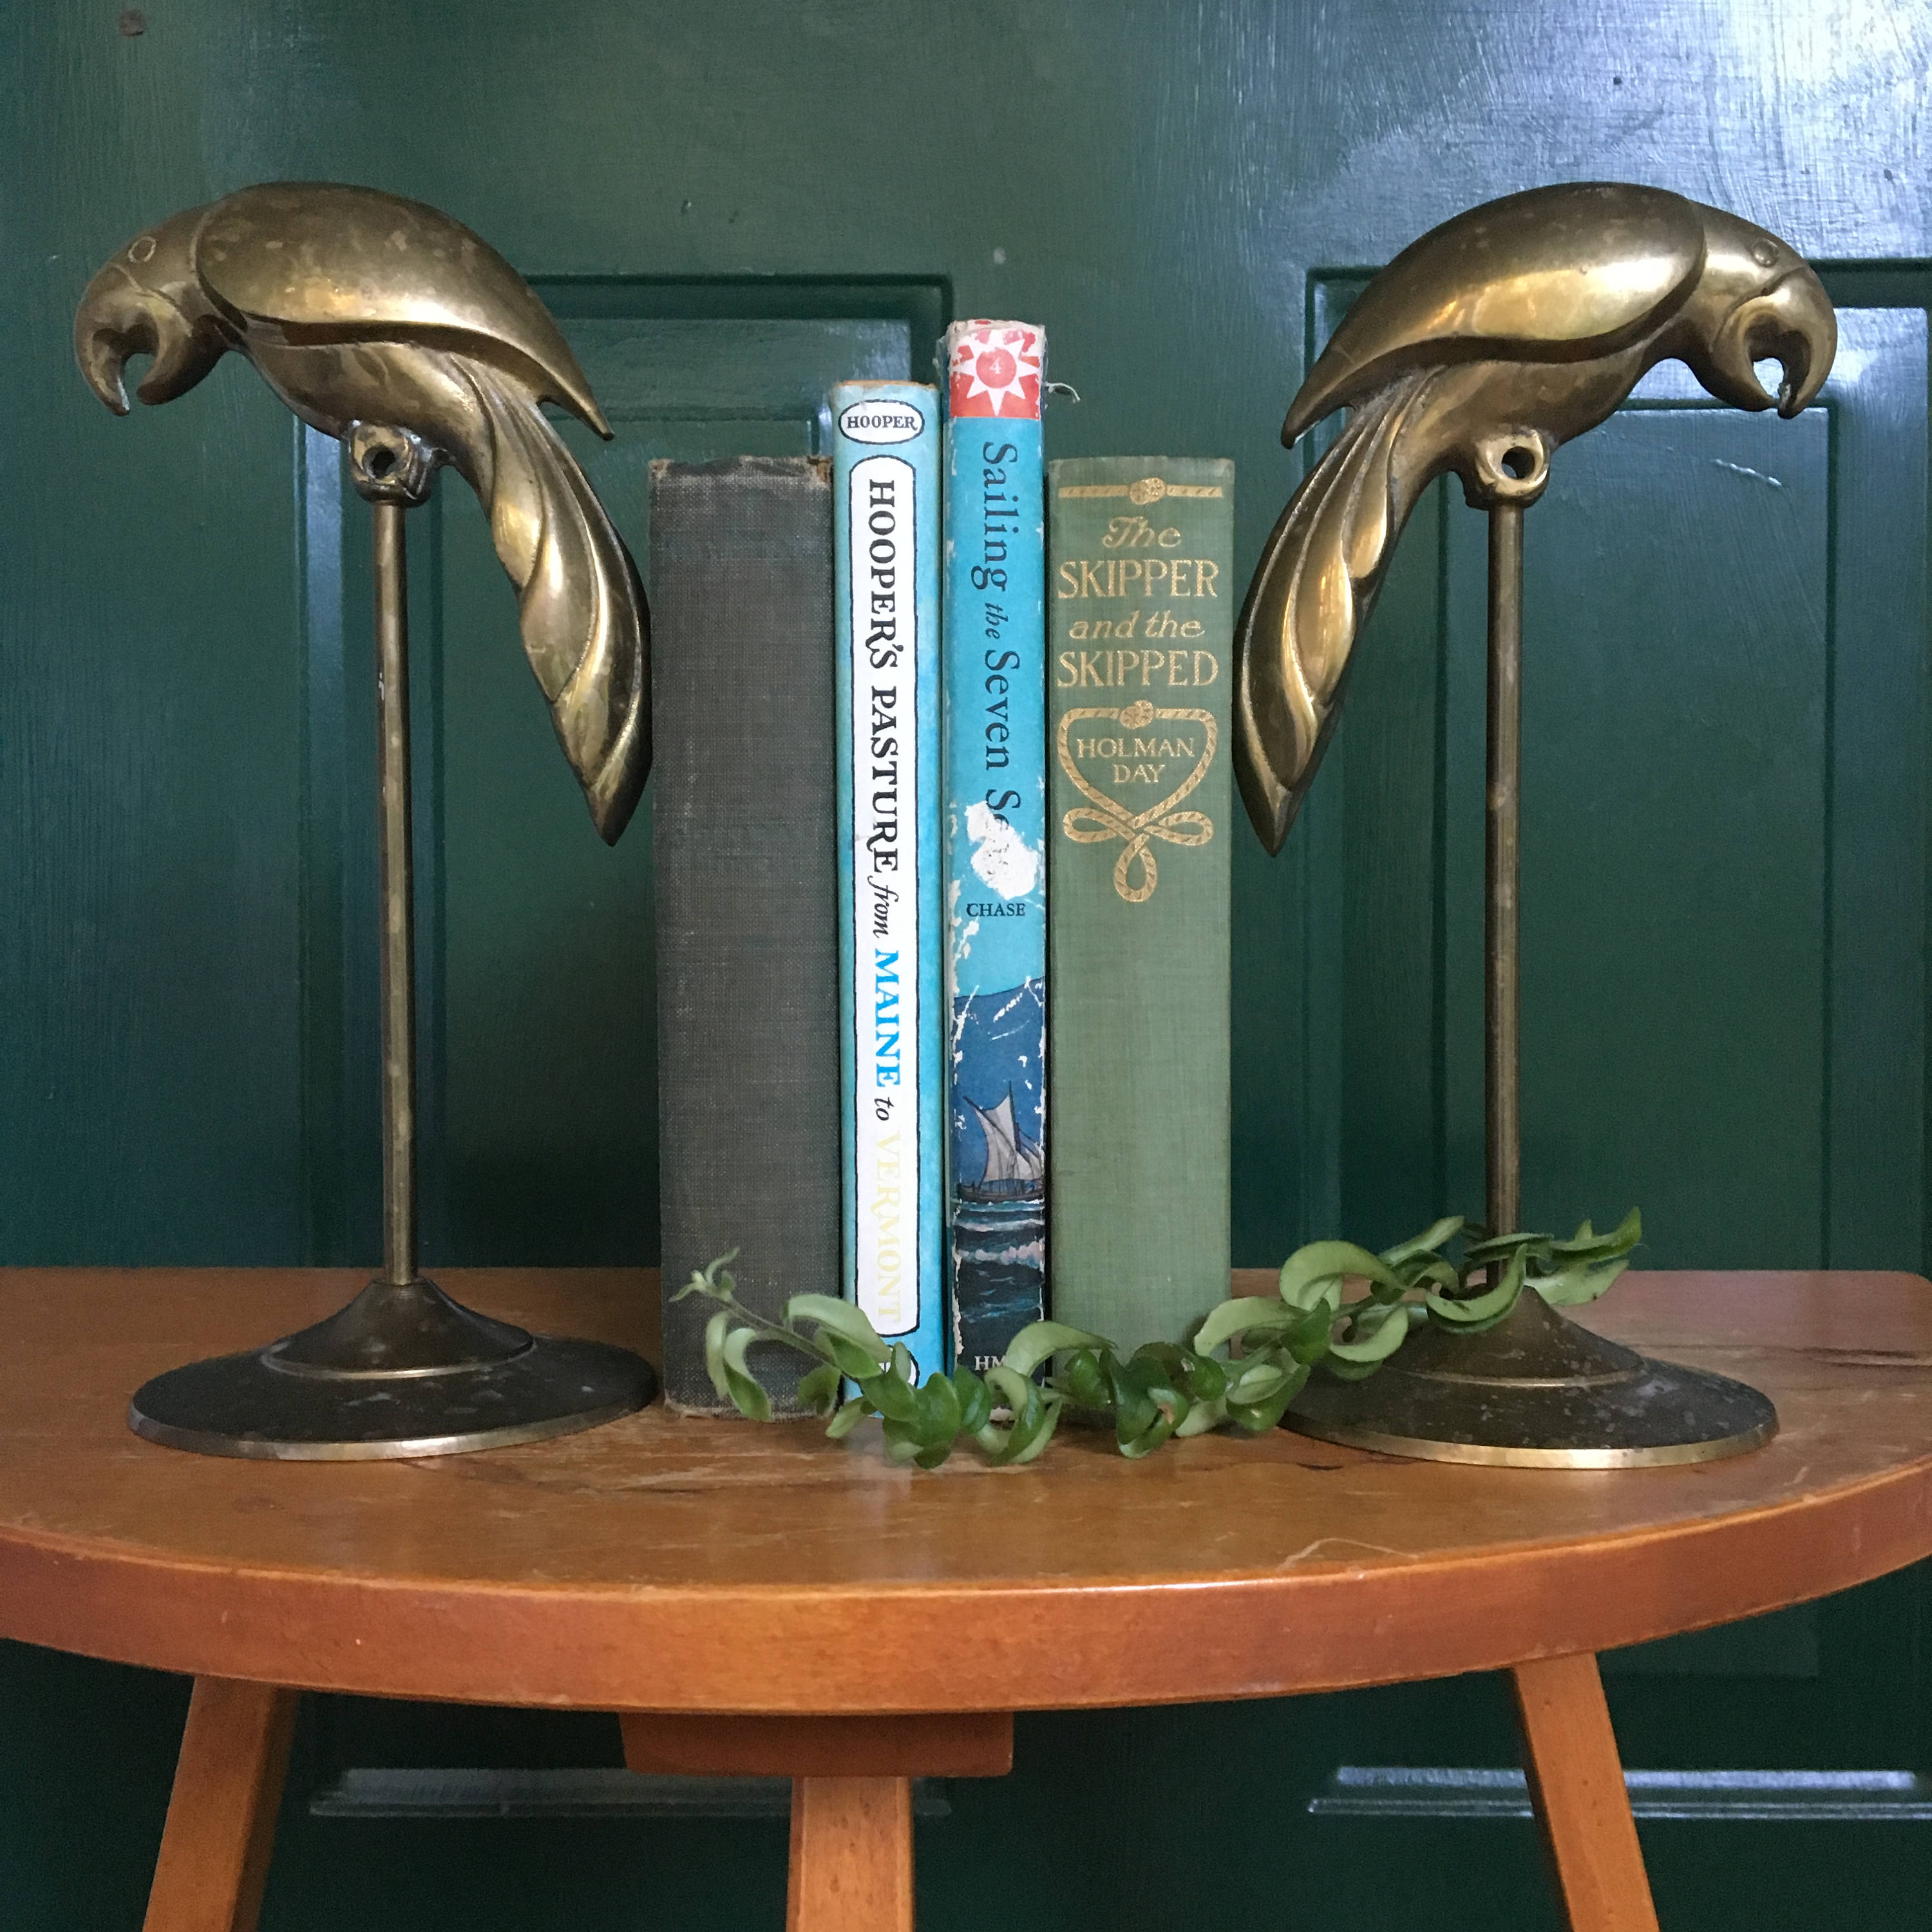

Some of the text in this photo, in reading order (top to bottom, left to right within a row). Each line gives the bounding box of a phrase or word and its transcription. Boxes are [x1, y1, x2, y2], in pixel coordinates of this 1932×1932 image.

[989, 357, 1001, 374] 4
[846, 415, 918, 431] HOOPER
[971, 441, 1019, 592] Sailing
[1102, 515, 1182, 548] The
[1057, 558, 1219, 599] SKIPPER
[984, 602, 1009, 639] the
[1068, 609, 1205, 639] and the
[1057, 649, 1218, 688] SKIPPED
[984, 649, 1020, 771] Seven
[1076, 737, 1195, 759] HOLMAN
[1113, 764, 1166, 784] DAY
[865, 478, 904, 1323] HOOPER'S PASTURE from MAINE to VERMONT
[966, 902, 1026, 918] CHASE
